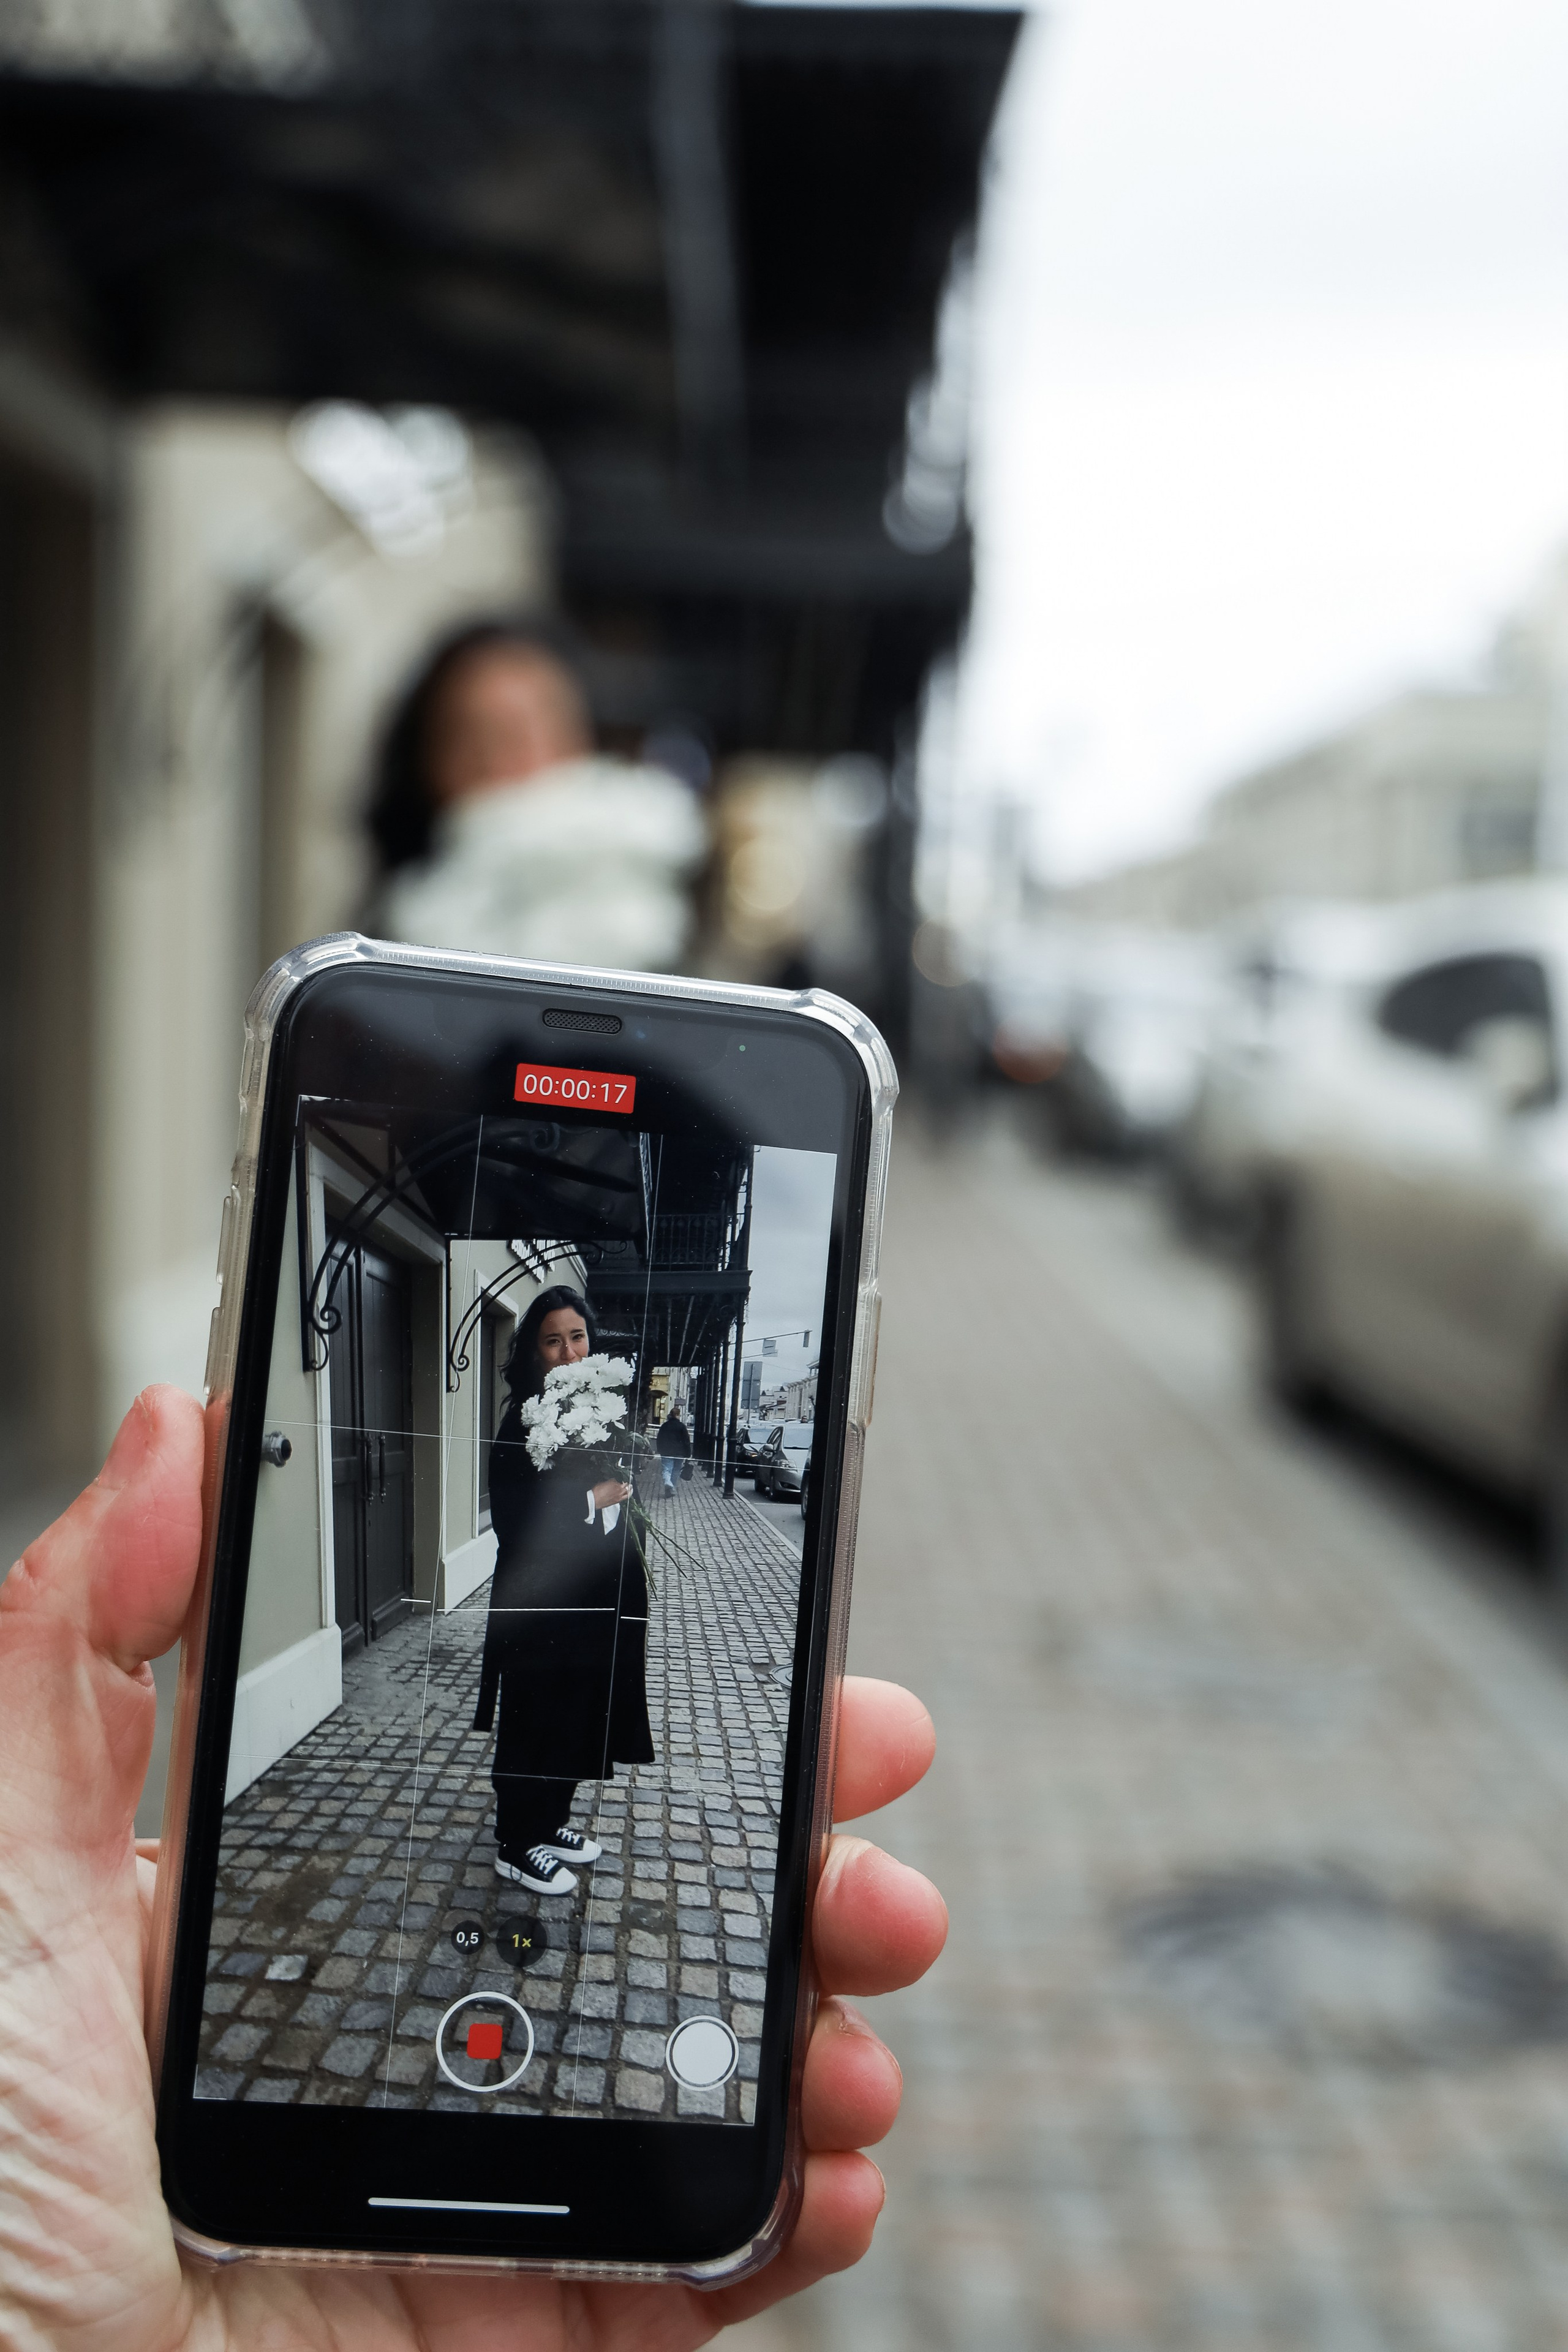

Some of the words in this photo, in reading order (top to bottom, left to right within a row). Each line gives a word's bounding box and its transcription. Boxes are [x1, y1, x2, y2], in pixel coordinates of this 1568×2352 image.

[524, 1074, 627, 1104] 00:00:17
[456, 1931, 479, 1947] 0,5
[512, 1934, 532, 1948] 1x
